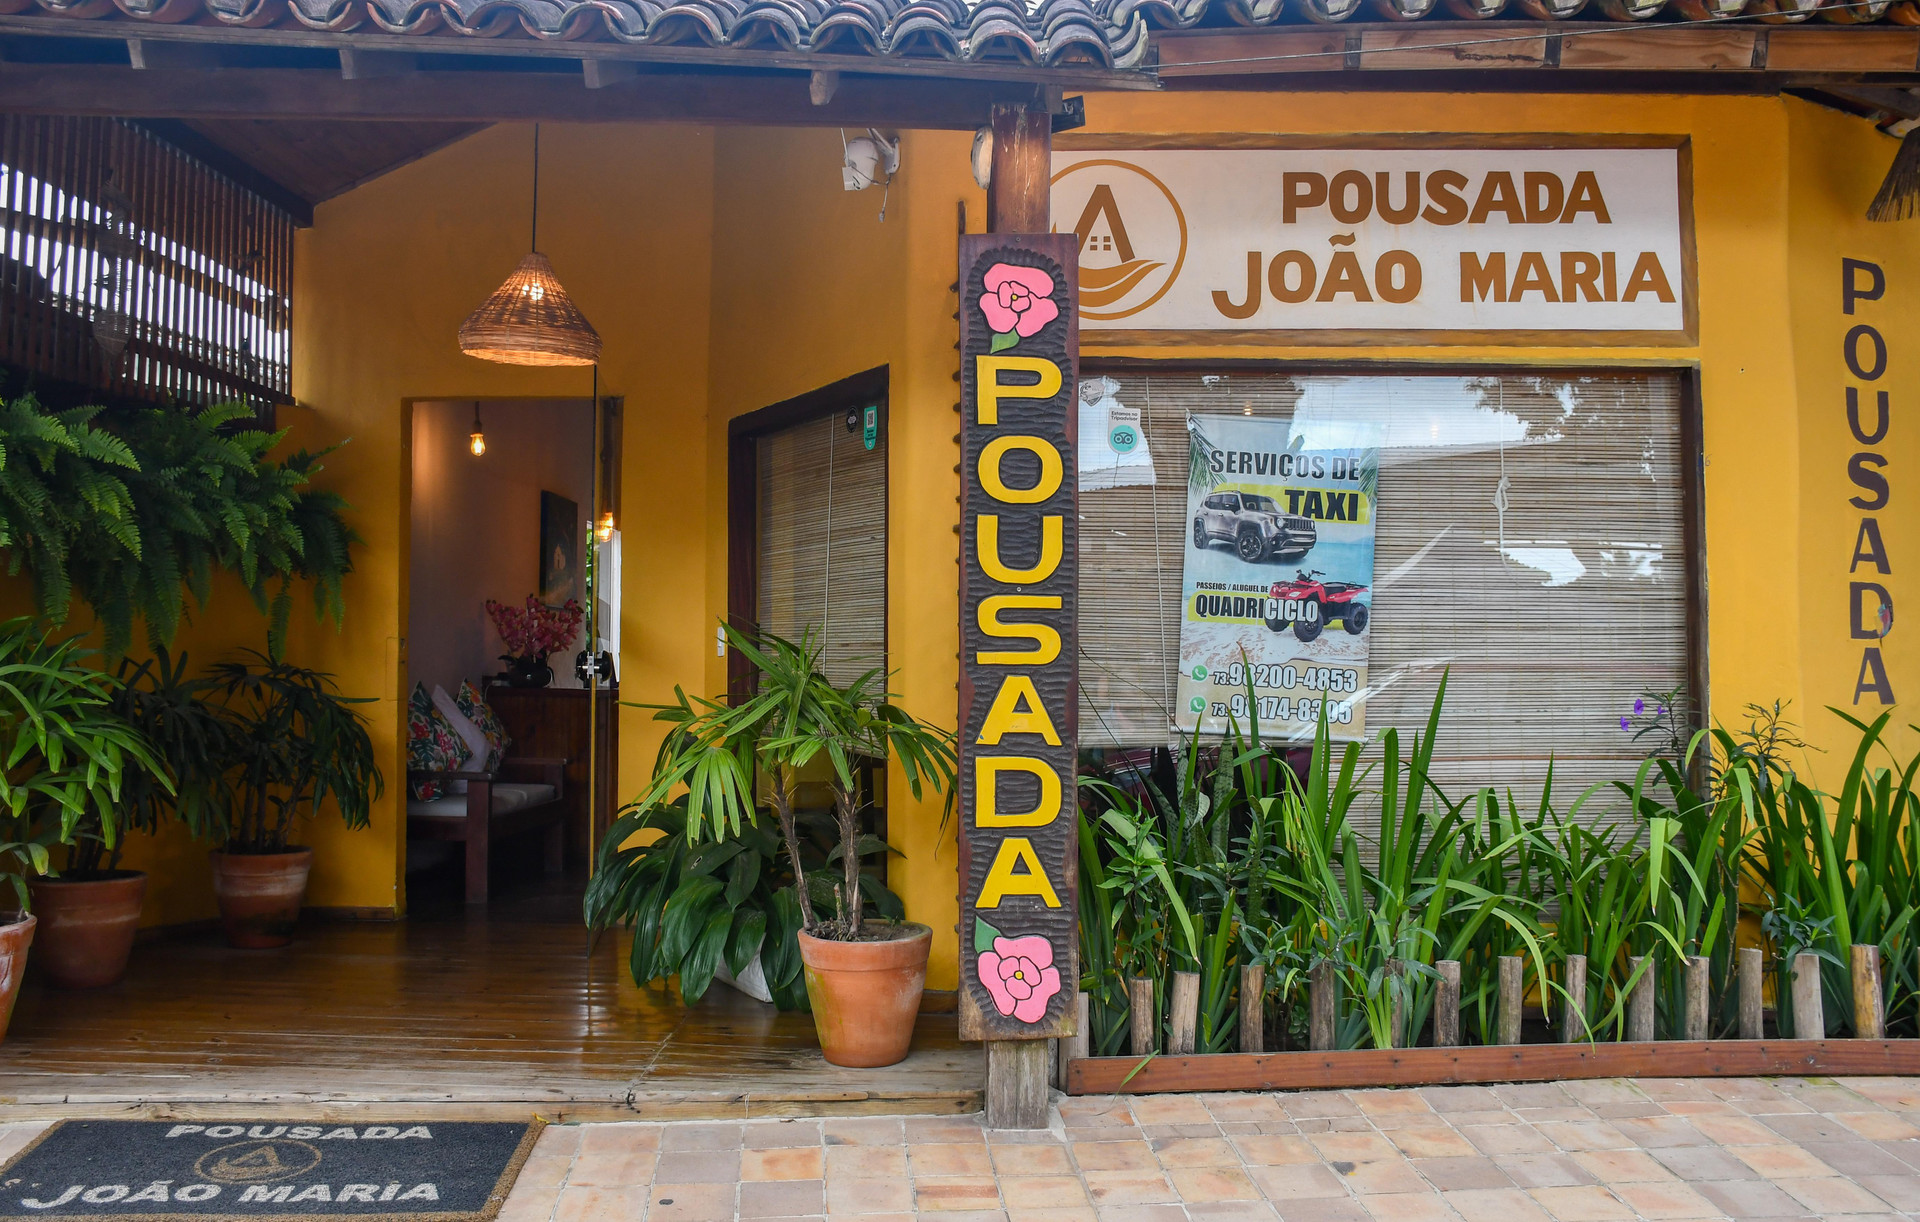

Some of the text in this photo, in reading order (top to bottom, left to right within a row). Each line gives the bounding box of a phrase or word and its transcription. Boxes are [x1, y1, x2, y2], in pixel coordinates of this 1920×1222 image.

[1282, 169, 1613, 227] POUSADA
[1211, 233, 1677, 320] JOÃO MARIA
[1210, 450, 1360, 481] SERVIÇOS DE
[1841, 256, 1897, 706] POUSADA
[1284, 489, 1359, 521] TAXI
[1196, 581, 1227, 591] PASSEIOS
[1232, 583, 1260, 593] ALUGUEL
[1260, 585, 1269, 593] DE
[1195, 594, 1319, 623] QUADRICICLO
[975, 354, 1064, 909] POUSADA
[165, 1124, 434, 1140] POUSADA
[21, 1179, 440, 1209] JOÃO MARIA
